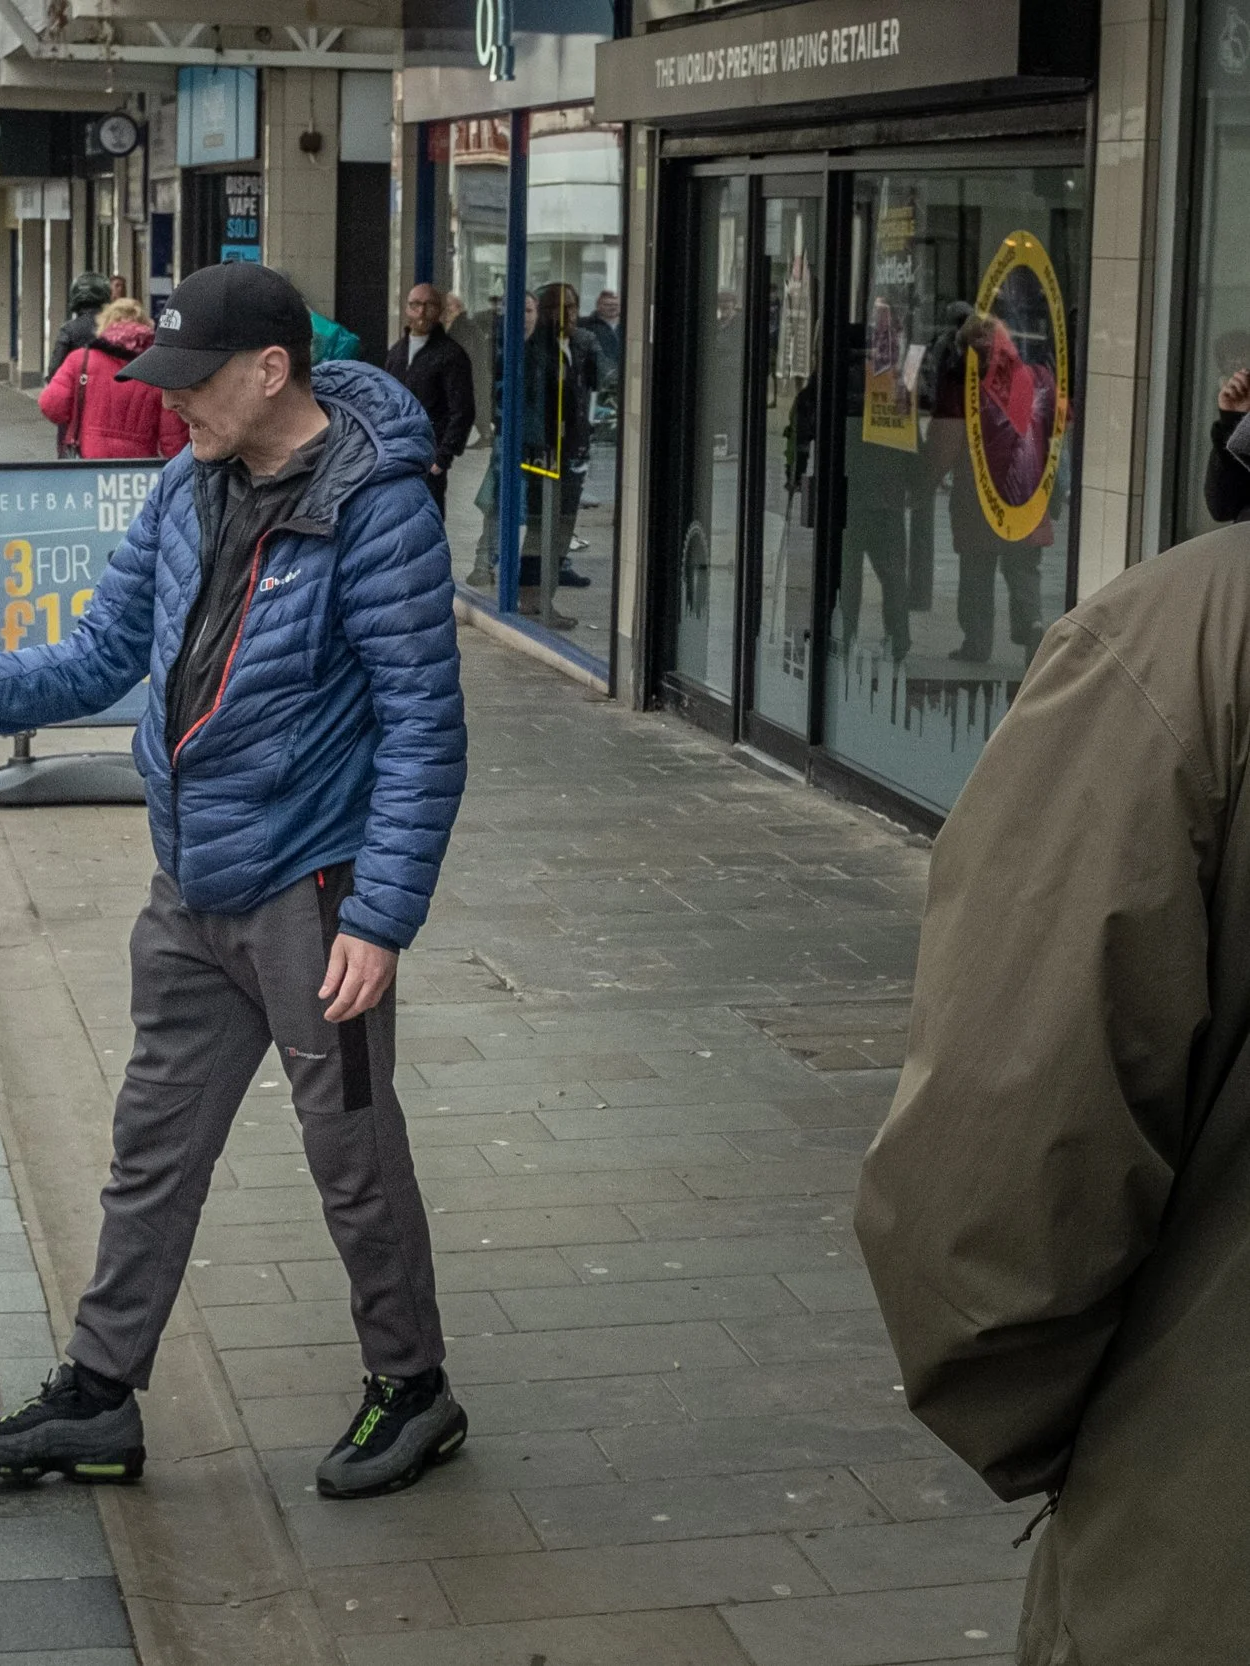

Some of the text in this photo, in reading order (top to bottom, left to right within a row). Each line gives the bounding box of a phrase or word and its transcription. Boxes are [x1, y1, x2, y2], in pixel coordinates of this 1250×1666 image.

[655, 18, 900, 89] THE WORLD'S PREMIER VAPING RETAILER
[228, 197, 257, 216] VAPE
[226, 218, 258, 239] SOLD
[98, 500, 145, 532] DE
[4, 538, 92, 598] 3 FOR
